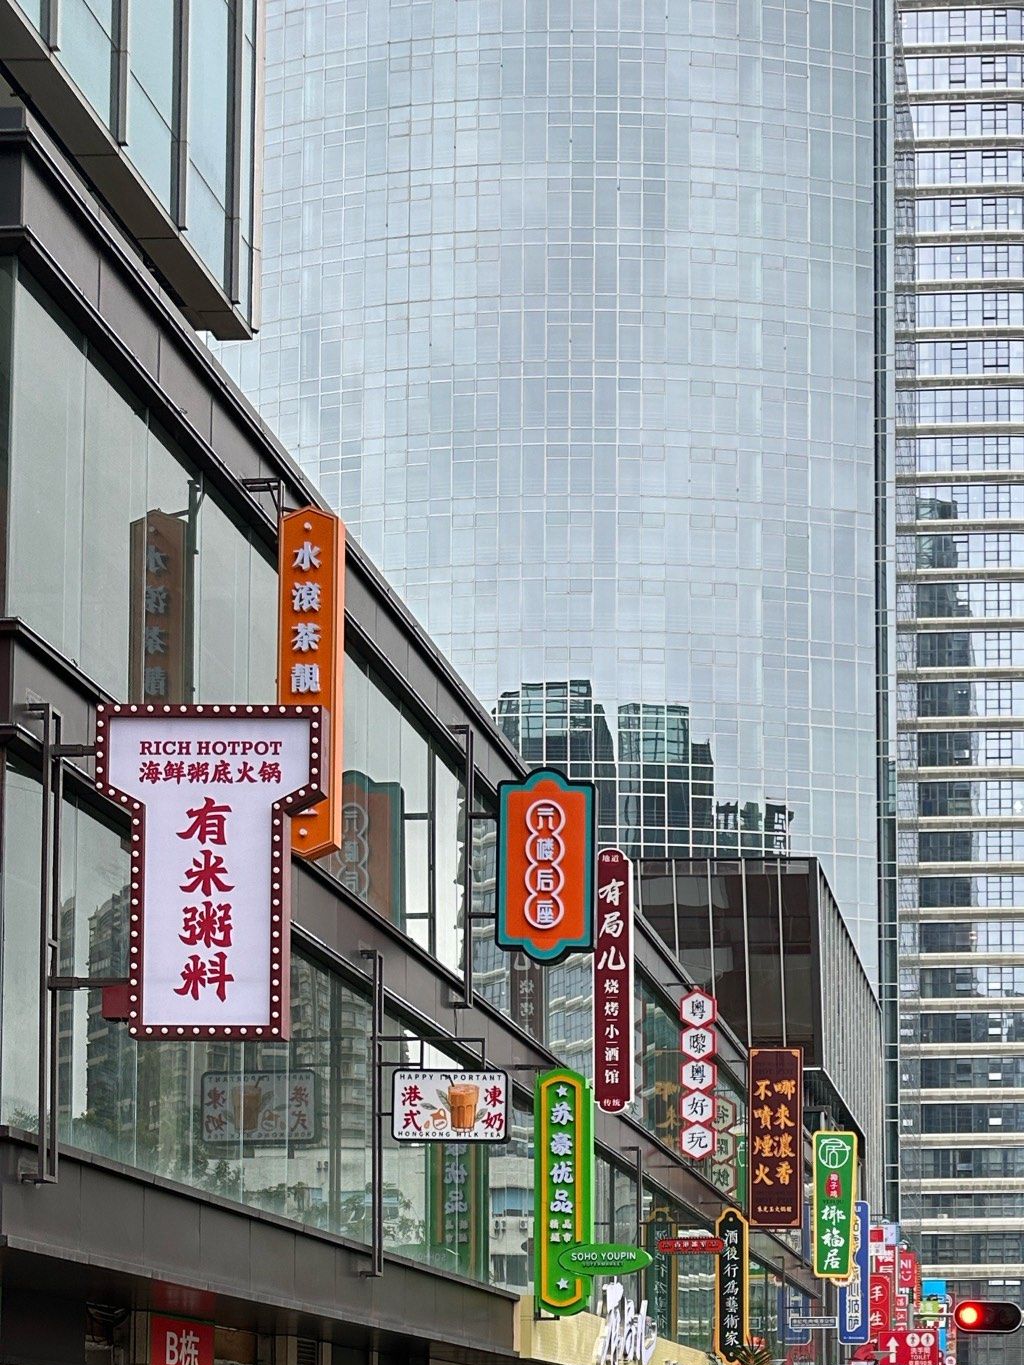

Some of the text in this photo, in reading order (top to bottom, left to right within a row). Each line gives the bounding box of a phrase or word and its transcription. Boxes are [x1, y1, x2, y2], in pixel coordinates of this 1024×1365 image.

[139, 740, 283, 757] RICH HOTPOT
[139, 760, 283, 785] 海鲜粥底火锅
[602, 853, 620, 864] 地道
[173, 796, 236, 1003] 有米粥料
[400, 1073, 502, 1081] HAPPY IMPORTANT
[401, 1084, 424, 1132] 港式
[602, 1098, 621, 1108] 传统
[549, 1101, 575, 1214] 苏豪优品
[820, 1205, 846, 1271] 椰福居
[570, 1251, 637, 1262] SOHO YOUPIN
